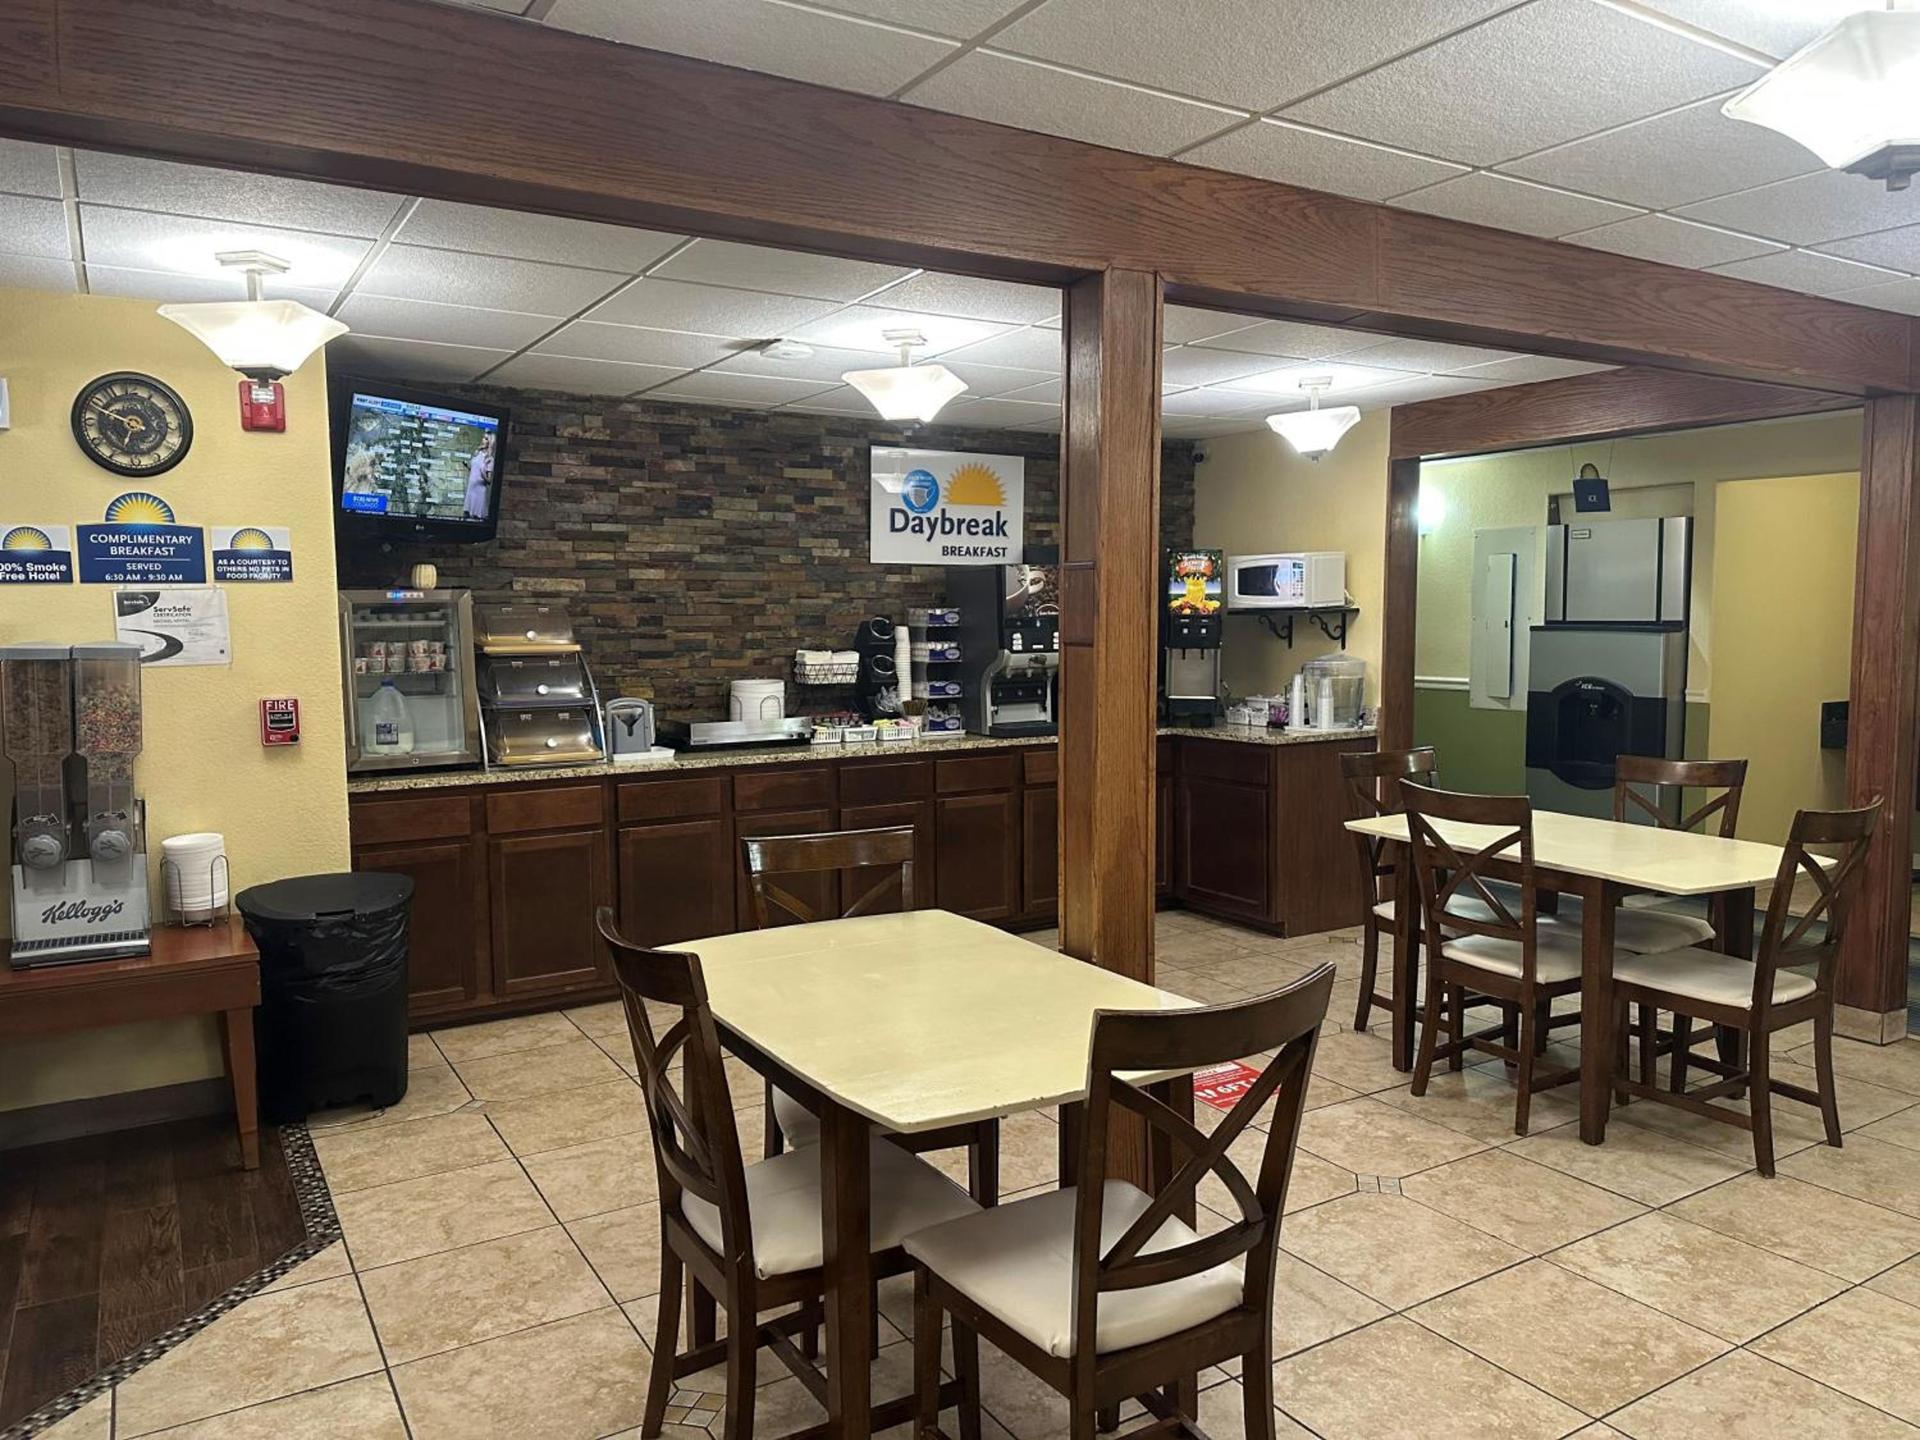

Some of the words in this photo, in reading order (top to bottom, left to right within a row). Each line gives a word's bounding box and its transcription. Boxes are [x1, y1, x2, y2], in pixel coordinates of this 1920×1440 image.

[890, 508, 1008, 542] Daybreak
[90, 534, 193, 544] COMPLIMENTARY
[110, 546, 175, 556] BREAKFAST
[942, 545, 1008, 557] BREAKFAST
[26, 562, 67, 572] Smoke
[126, 562, 162, 571] SERVED
[0, 571, 26, 580] Free
[28, 571, 60, 580] Hotel
[153, 605, 192, 613] ServSafe
[265, 700, 295, 710] FIRE
[41, 899, 124, 924] Kellogg's
